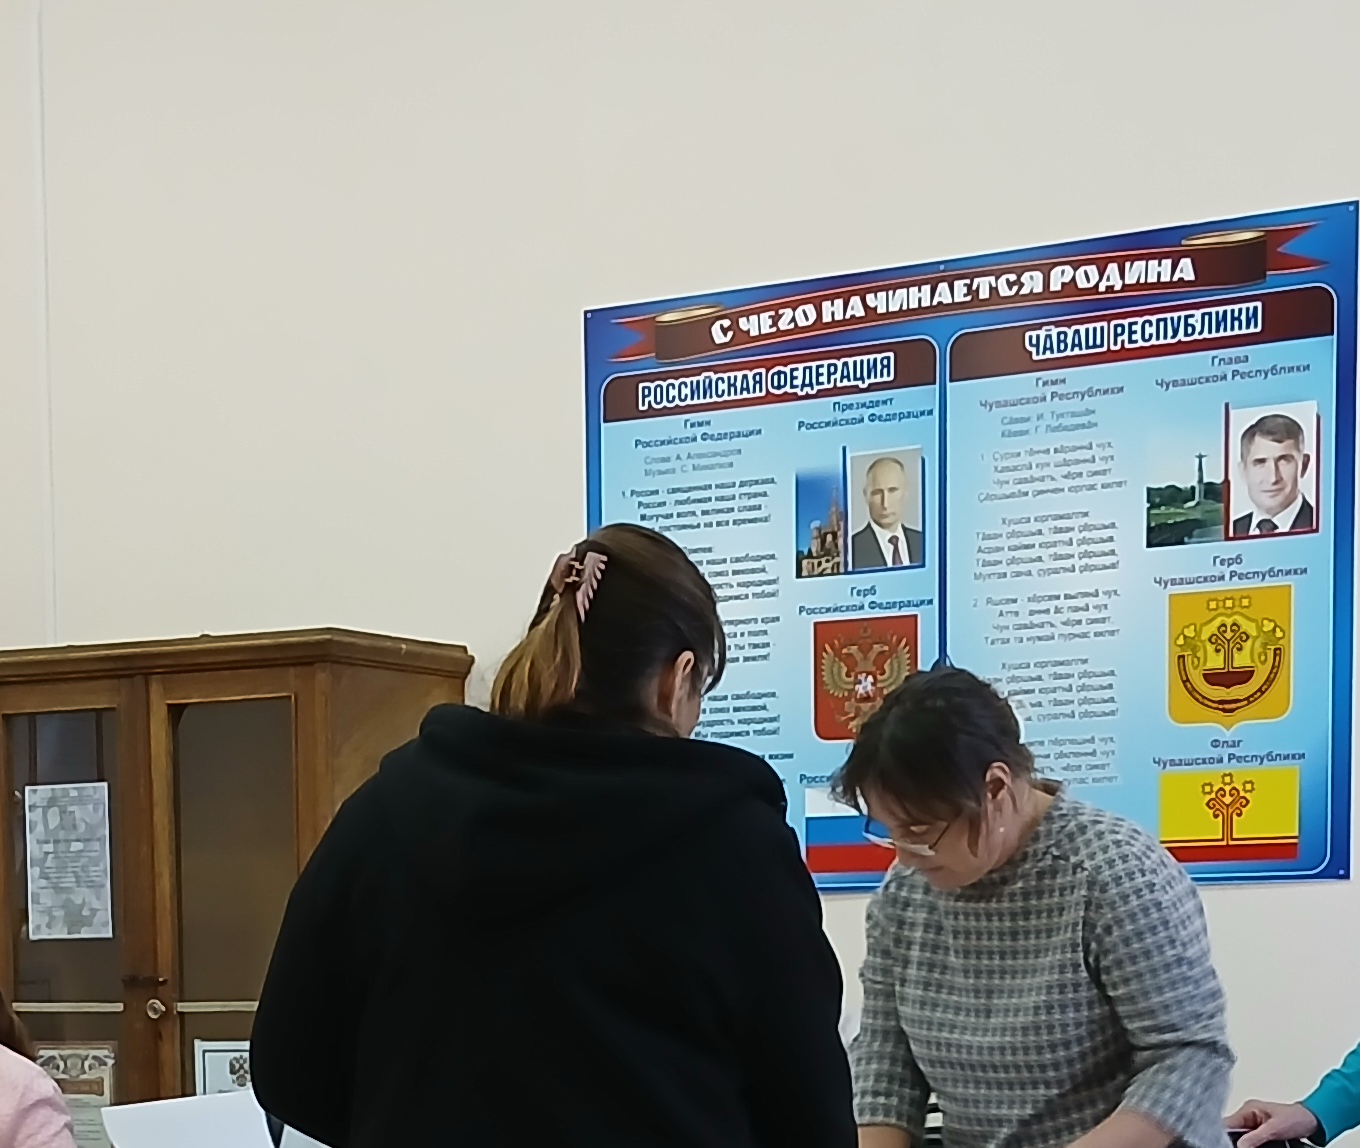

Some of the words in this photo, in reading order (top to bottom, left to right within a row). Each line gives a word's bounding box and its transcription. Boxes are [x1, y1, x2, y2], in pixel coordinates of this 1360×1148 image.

[710, 319, 733, 345] С
[822, 273, 1045, 323] НАЧИНАЕТСЯ
[1050, 258, 1196, 291] РОДИНА
[1112, 304, 1260, 348] РЕСПУБЛИКИ
[1211, 354, 1249, 368] Глава
[640, 370, 763, 408] РОССИЙСКАЯ
[769, 354, 893, 393] ФЕДЕРАЦИЯ
[1036, 377, 1066, 387] Гимн
[1156, 370, 1228, 391] Чувашской
[1231, 362, 1310, 382] Республики
[832, 397, 894, 413] Президент
[980, 393, 1046, 412] Чувашской
[1050, 386, 1124, 402] Республики
[684, 419, 711, 429] Гимн
[797, 416, 864, 431] Российской
[868, 407, 934, 423] Федерации
[635, 433, 697, 449] Российской
[701, 428, 761, 442] Федерации
[1213, 554, 1243, 568] Герб
[1154, 572, 1225, 589] Чувашской
[1229, 567, 1307, 582] Республики
[850, 585, 877, 598] Герб
[799, 602, 865, 616] Российской
[868, 598, 933, 611] Федерации
[1210, 739, 1243, 749] Флаг
[1153, 754, 1224, 770] Чувашской
[1228, 751, 1305, 765] Республики
